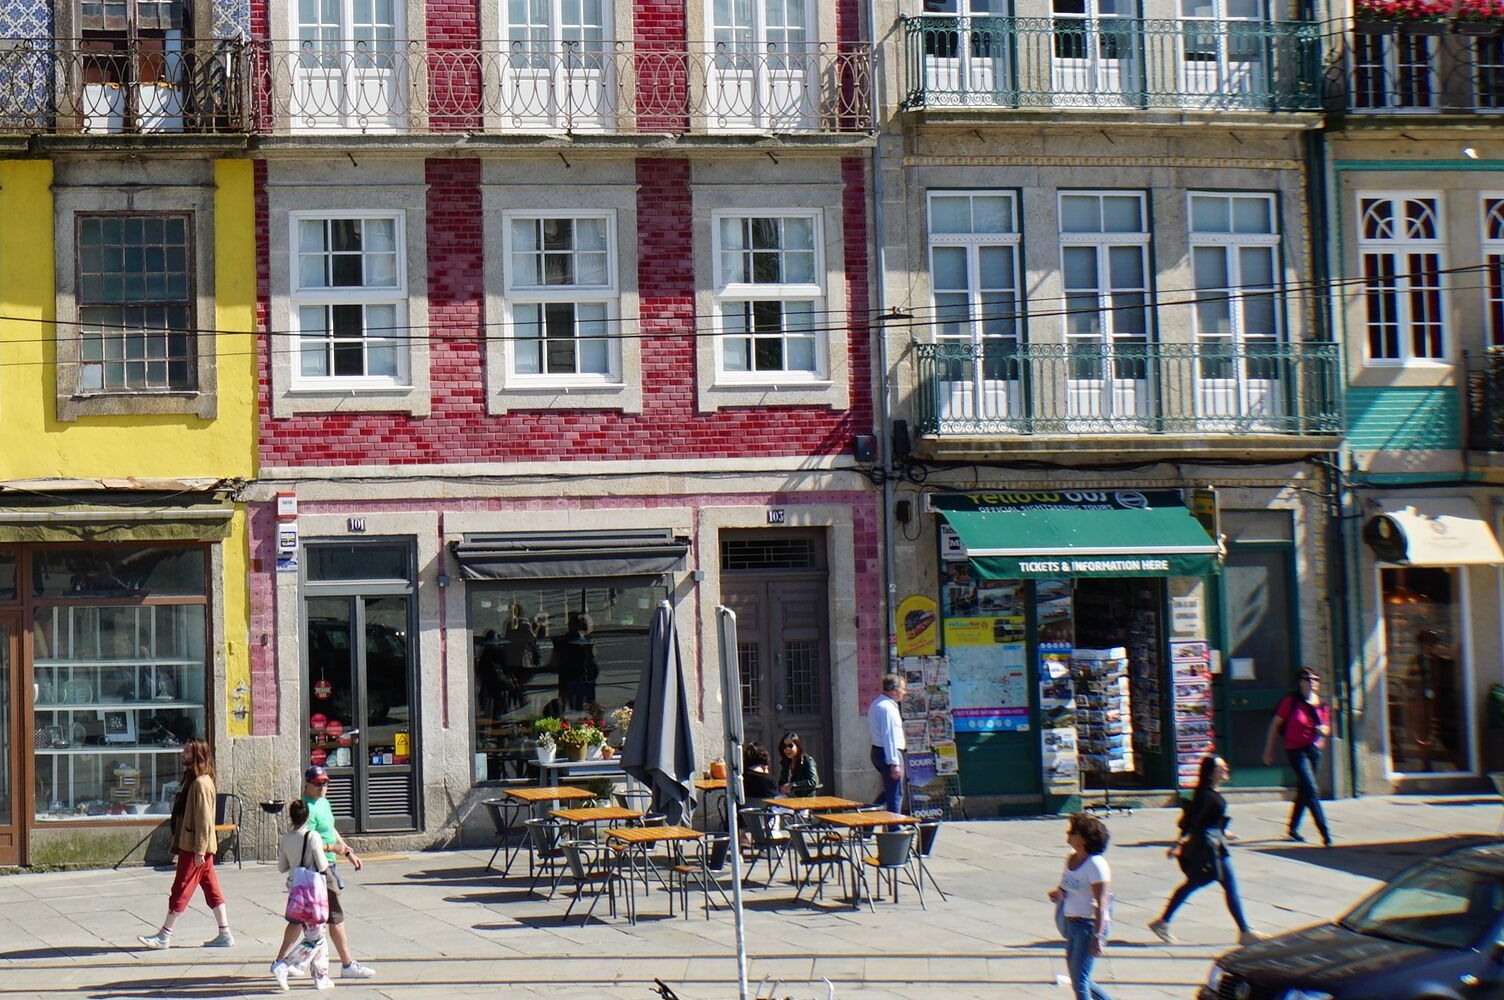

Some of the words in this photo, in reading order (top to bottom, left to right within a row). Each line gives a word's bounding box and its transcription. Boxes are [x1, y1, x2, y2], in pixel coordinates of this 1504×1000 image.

[769, 510, 784, 522] 103
[350, 519, 364, 530] 101
[1019, 561, 1060, 572] TICKETS
[1061, 561, 1070, 572] &
[1072, 560, 1140, 572] INFORMATION
[1142, 559, 1169, 571] HERE
